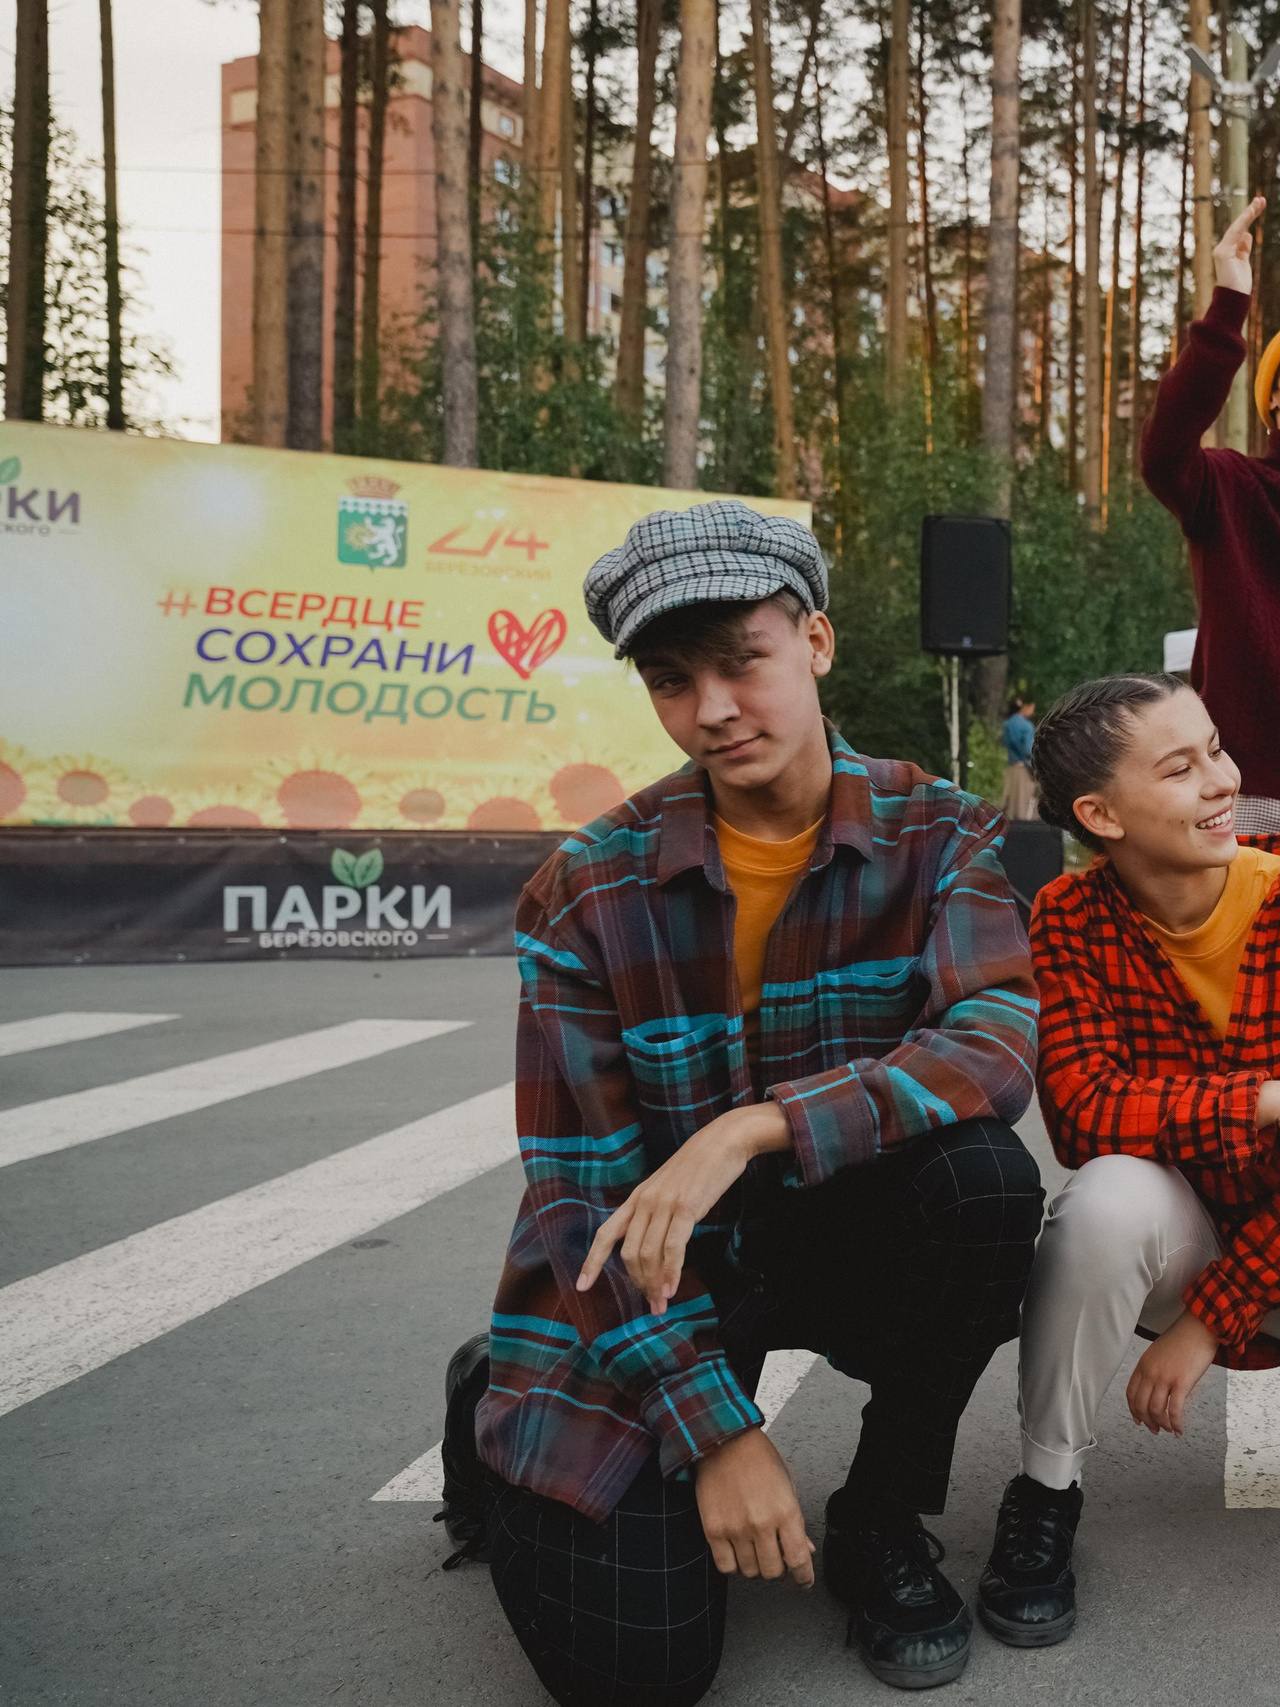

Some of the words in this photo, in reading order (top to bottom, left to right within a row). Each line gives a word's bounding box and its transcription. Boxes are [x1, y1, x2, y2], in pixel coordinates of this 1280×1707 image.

[0, 486, 80, 523] КИ
[157, 586, 425, 630] #ВСЕРДЦЕ
[195, 628, 475, 676] СОХРАНИ
[182, 673, 557, 725] МОЛОДОСТЬ
[223, 885, 452, 932] ПАРКИ
